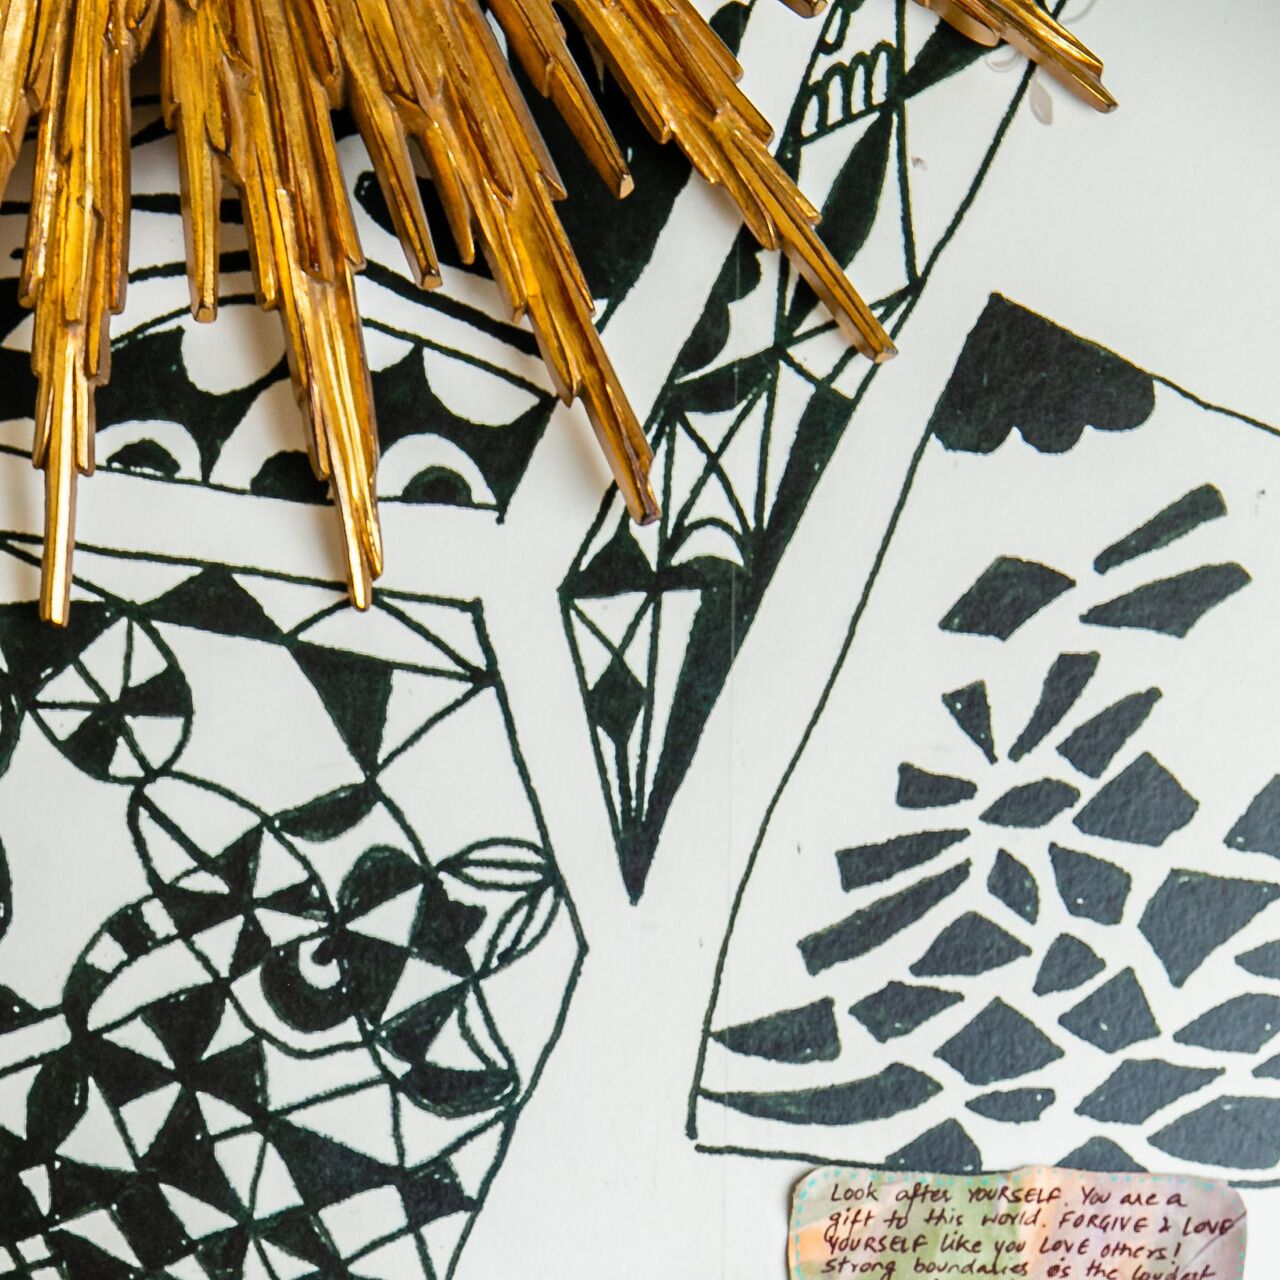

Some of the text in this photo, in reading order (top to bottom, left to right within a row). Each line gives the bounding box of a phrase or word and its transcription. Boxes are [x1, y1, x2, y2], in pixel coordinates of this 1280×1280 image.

[831, 1183, 879, 1201] Look
[896, 1183, 953, 1222] after
[1082, 1187, 1111, 1205] You
[1120, 1193, 1160, 1207] are
[1166, 1194, 1188, 1207] a
[824, 1208, 875, 1243] gift
[884, 1211, 908, 1230] to
[924, 1207, 964, 1227] this
[1059, 1210, 1149, 1233] FORGIVE
[1182, 1217, 1234, 1236] LOVE
[829, 1232, 1181, 1267] YOURSELF like you LOVE others!
[1085, 1260, 1118, 1280] the
